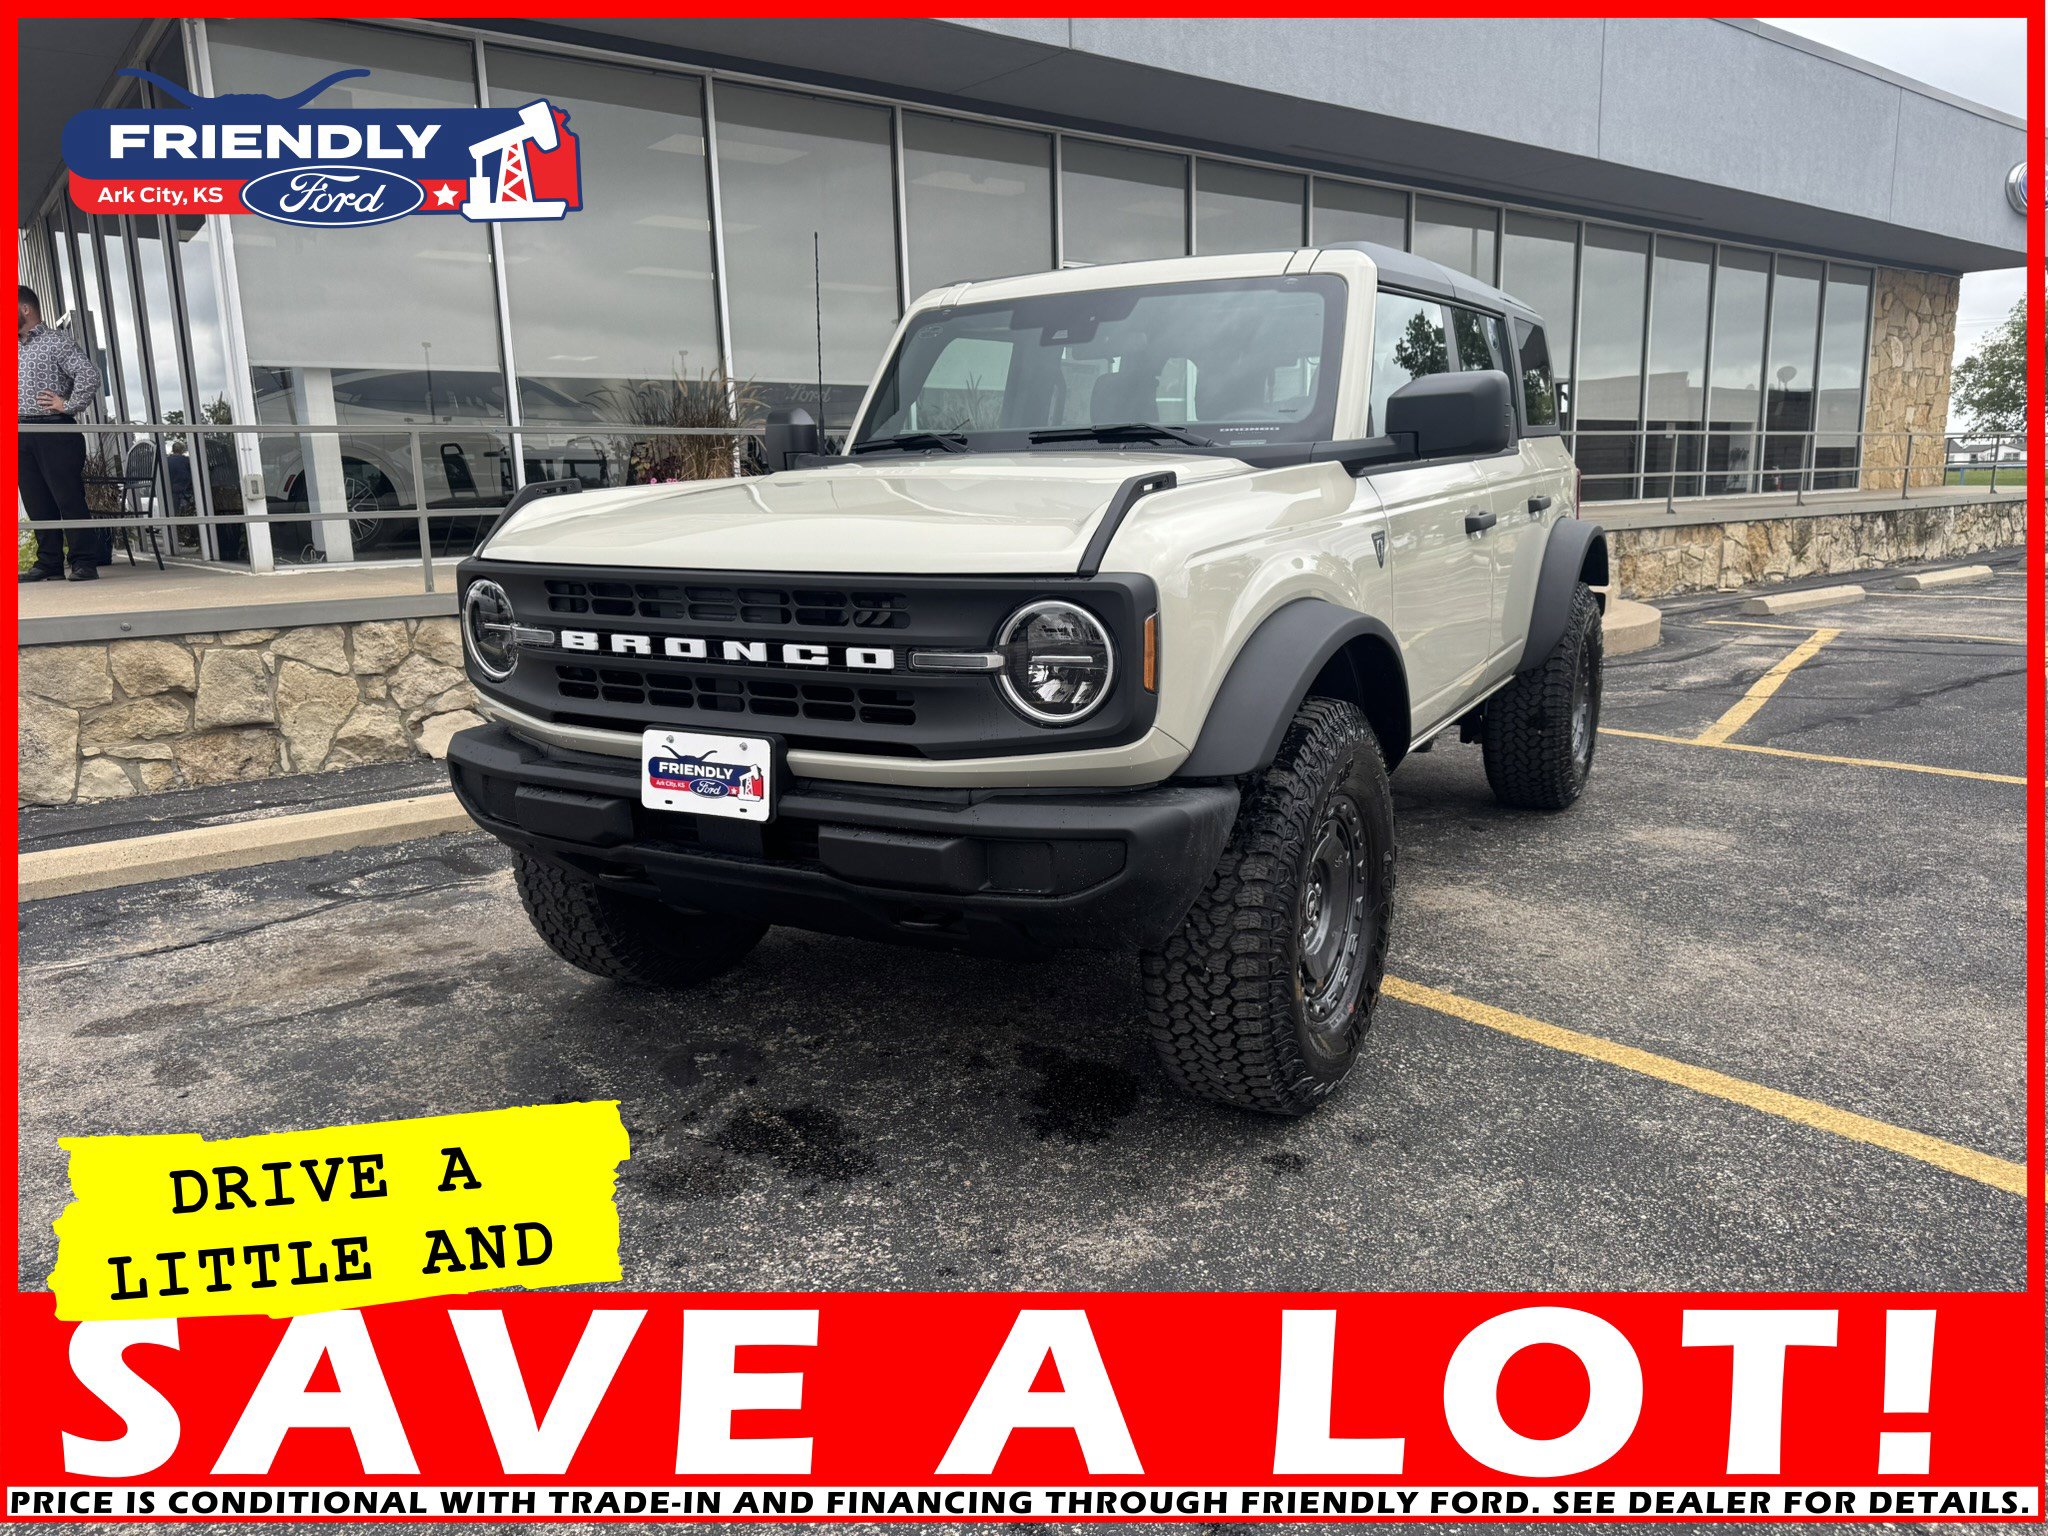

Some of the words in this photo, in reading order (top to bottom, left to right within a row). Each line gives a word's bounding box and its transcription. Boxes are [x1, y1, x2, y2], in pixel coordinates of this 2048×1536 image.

[561, 630, 894, 669] BRONCO
[658, 761, 733, 780] FRIENDLY
[656, 779, 665, 787] Ark
[697, 780, 721, 795] Ford
